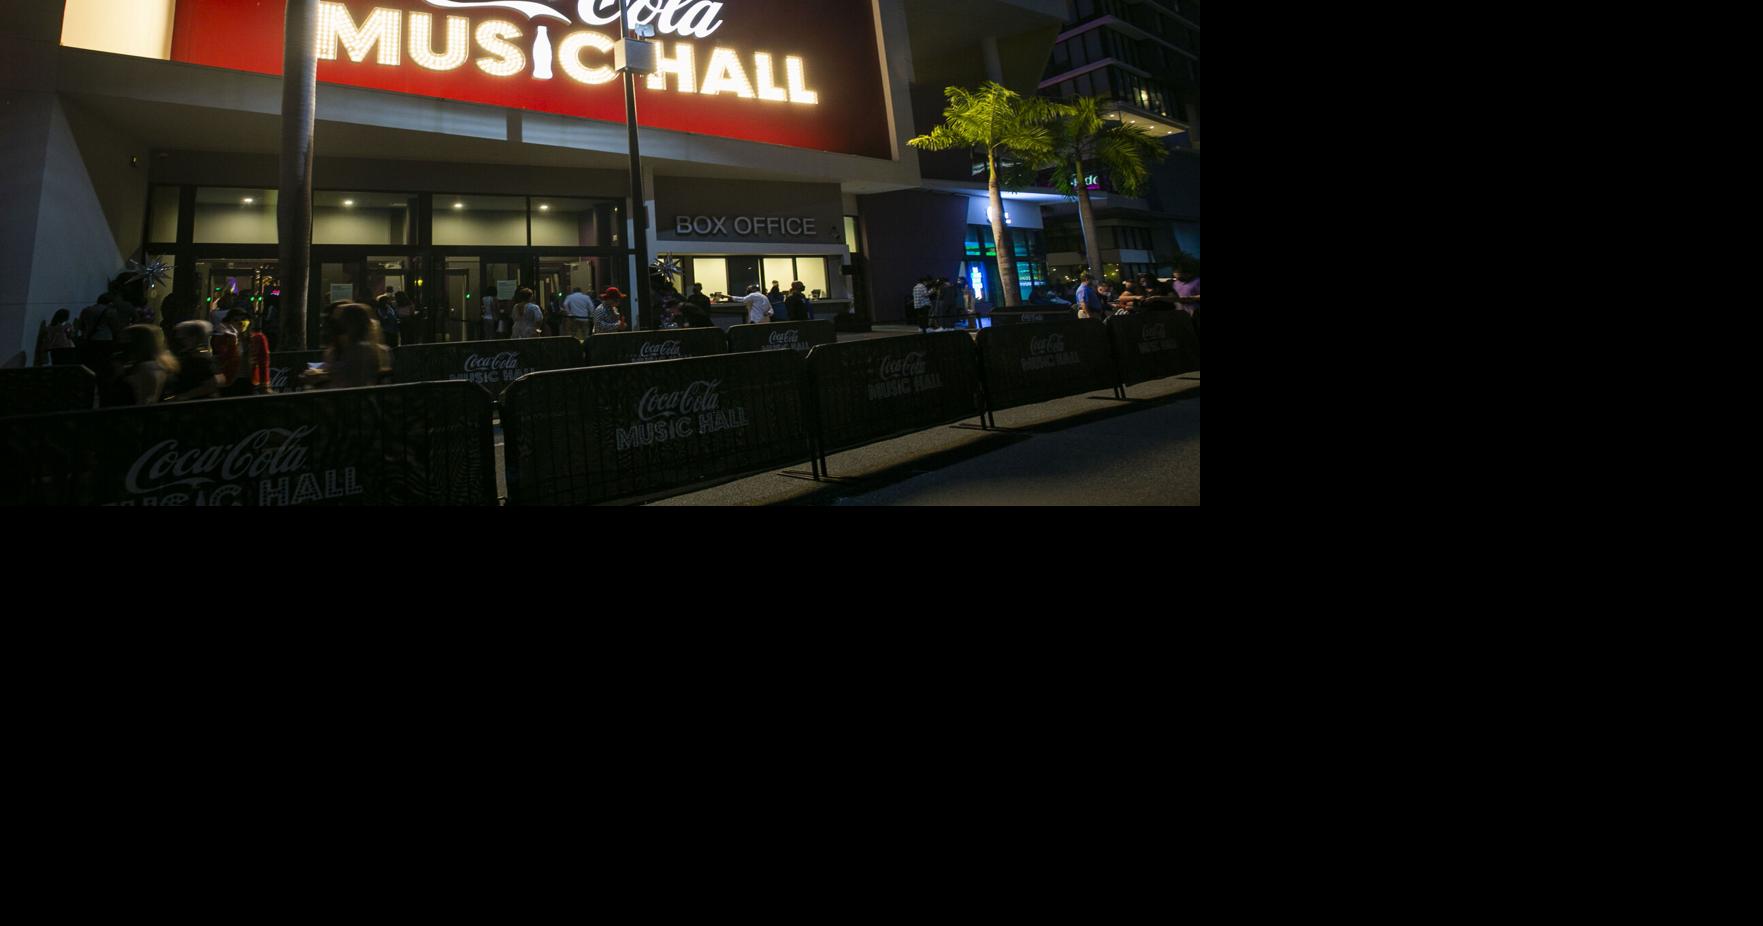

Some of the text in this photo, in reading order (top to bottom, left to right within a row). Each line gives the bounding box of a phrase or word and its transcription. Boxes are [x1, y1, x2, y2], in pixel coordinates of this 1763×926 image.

[316, 3, 818, 104] MUSIC HALL
[676, 215, 817, 235] BOX OFFICE
[615, 407, 749, 450] MUSIC HALL
[258, 465, 364, 506] HALL
